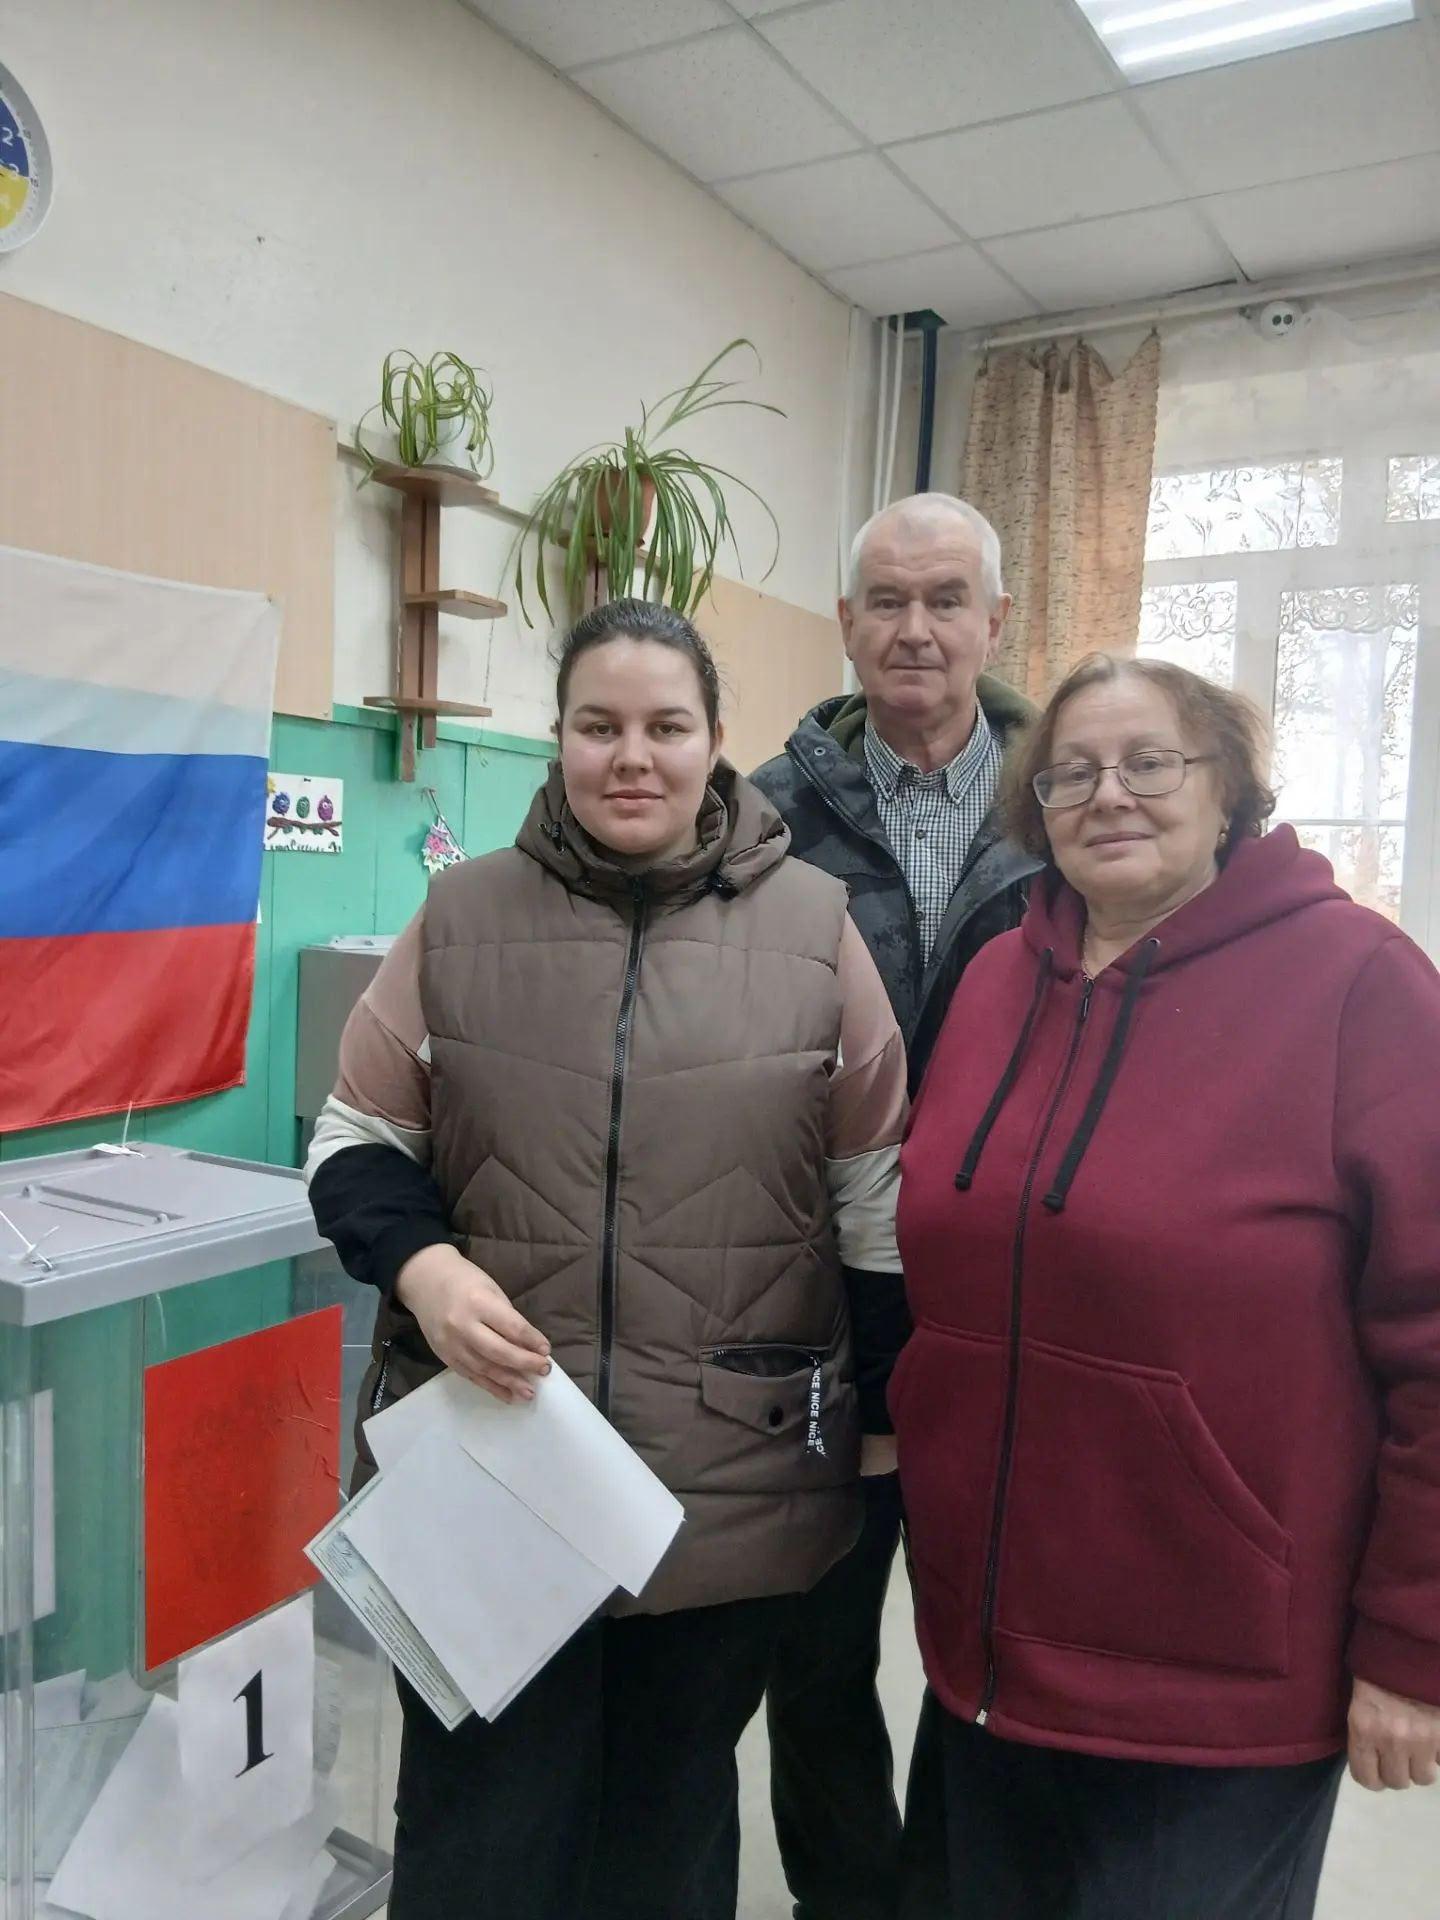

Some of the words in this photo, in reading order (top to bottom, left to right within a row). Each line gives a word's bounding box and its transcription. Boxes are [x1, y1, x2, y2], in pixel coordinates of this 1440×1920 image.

[2, 127, 13, 147] 2
[810, 1392, 821, 1418] NICE
[807, 1421, 818, 1447] NICE
[233, 1669, 274, 1778] 1
